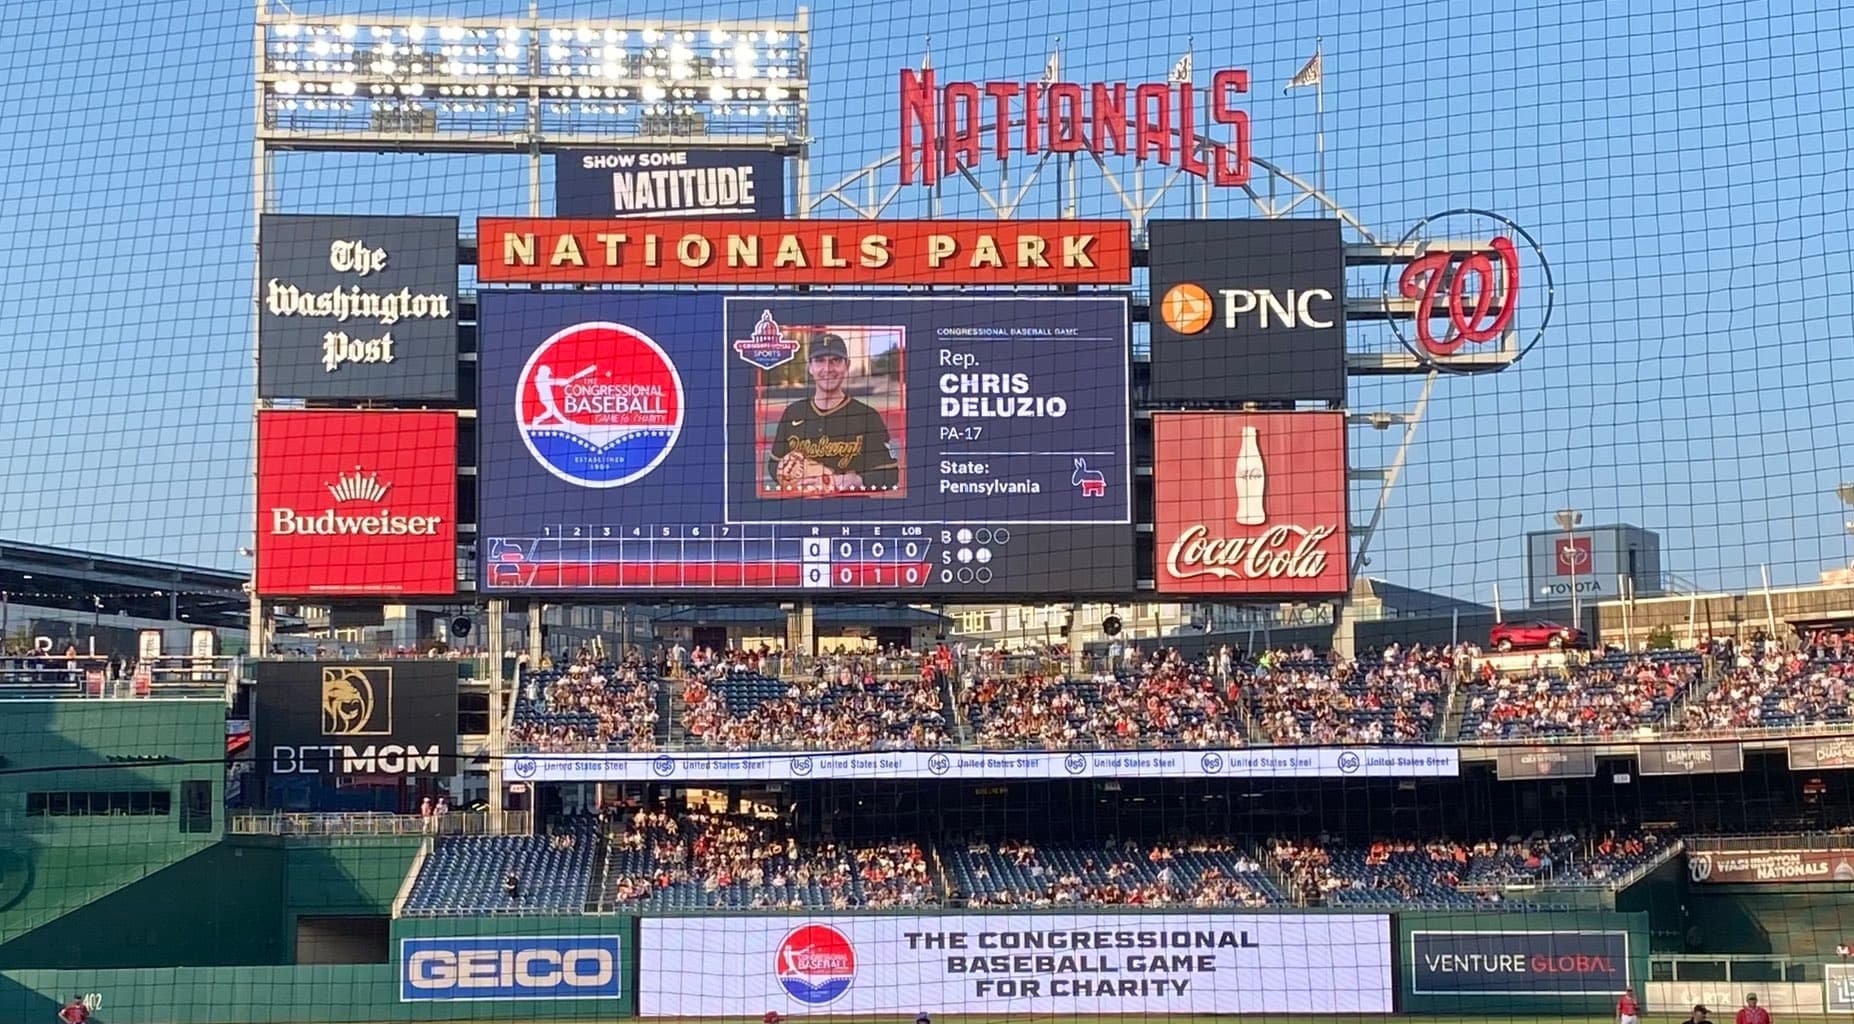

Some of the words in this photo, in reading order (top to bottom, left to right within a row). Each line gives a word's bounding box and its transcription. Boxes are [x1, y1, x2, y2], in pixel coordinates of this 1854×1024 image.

[900, 68, 1251, 187] NATIONALS
[583, 155, 635, 168] SHOW
[639, 152, 687, 166] SOME
[613, 166, 755, 210] NATITUDE
[329, 239, 388, 276] The
[503, 233, 891, 269] NATIONALS
[928, 234, 1097, 269] PARK
[266, 278, 450, 325] Washington
[1218, 289, 1335, 329] PNC
[937, 327, 1009, 336] CONGRESSIONAL
[1010, 327, 1052, 336] BASEBALL
[1054, 327, 1079, 336] GAME
[322, 331, 394, 373] Post
[939, 349, 980, 369] Rep.
[563, 385, 667, 397] CONGRESSIONAL
[939, 373, 1030, 394] CHRIS
[564, 397, 668, 413] BASEBALL
[940, 397, 1067, 418] DELUZIO
[939, 427, 983, 440] PA-17
[939, 461, 990, 475] State:
[939, 479, 1040, 496] Pennsylvania
[271, 509, 442, 536] Budweiser
[543, 527, 551, 536] 1
[573, 527, 581, 536] 2
[603, 527, 610, 536] 3
[633, 527, 641, 536] 4
[662, 527, 670, 536] 5
[692, 527, 700, 536] 6
[722, 527, 729, 536] 7
[811, 527, 819, 536] R
[842, 527, 850, 536] H
[874, 527, 881, 536] E
[902, 527, 922, 536] LOB
[941, 531, 952, 544] B
[810, 543, 820, 557] 0
[840, 543, 851, 557] 0
[872, 543, 884, 557] 0
[905, 543, 917, 557] 0
[942, 551, 952, 564] S
[1166, 523, 1337, 579] Coca-Cola
[810, 568, 820, 582] 0
[840, 568, 852, 583] 0
[873, 568, 881, 583] 1
[905, 568, 918, 583] 0
[1549, 581, 1602, 595] TOYOTA
[273, 745, 440, 773] BETMGM
[544, 761, 572, 771] United
[575, 761, 602, 771] States
[604, 761, 627, 771] Steel
[683, 760, 710, 770] United
[713, 760, 741, 770] States
[742, 760, 765, 770] Steel
[820, 759, 847, 769] United
[850, 759, 877, 769] States
[880, 759, 902, 769] Steel
[957, 758, 985, 769] United
[987, 758, 1015, 769] States
[1017, 758, 1039, 769] Steel
[1094, 757, 1121, 768] United
[1124, 757, 1151, 768] States
[1153, 757, 1175, 768] Steel
[1230, 757, 1258, 767] United
[1260, 757, 1287, 767] States
[1290, 757, 1312, 767] Steel
[1367, 756, 1395, 767] United
[1397, 756, 1424, 767] States
[1426, 756, 1450, 767] Steel
[1716, 854, 1801, 872] WASHINGTON
[1757, 862, 1829, 880] NATIONALS
[904, 932, 968, 950] THE
[978, 930, 1259, 950] CONGRESSIONAL
[408, 948, 613, 989] GEICO
[798, 959, 849, 970] BASEBALL
[947, 955, 1119, 974] BASEBALL
[1127, 954, 1217, 973] GAME
[1424, 954, 1526, 973] VENTURE
[1531, 954, 1617, 973] GLOBAL
[976, 979, 1041, 998] FOR
[1050, 978, 1192, 997] CHARITY
[83, 993, 102, 1011] 402
